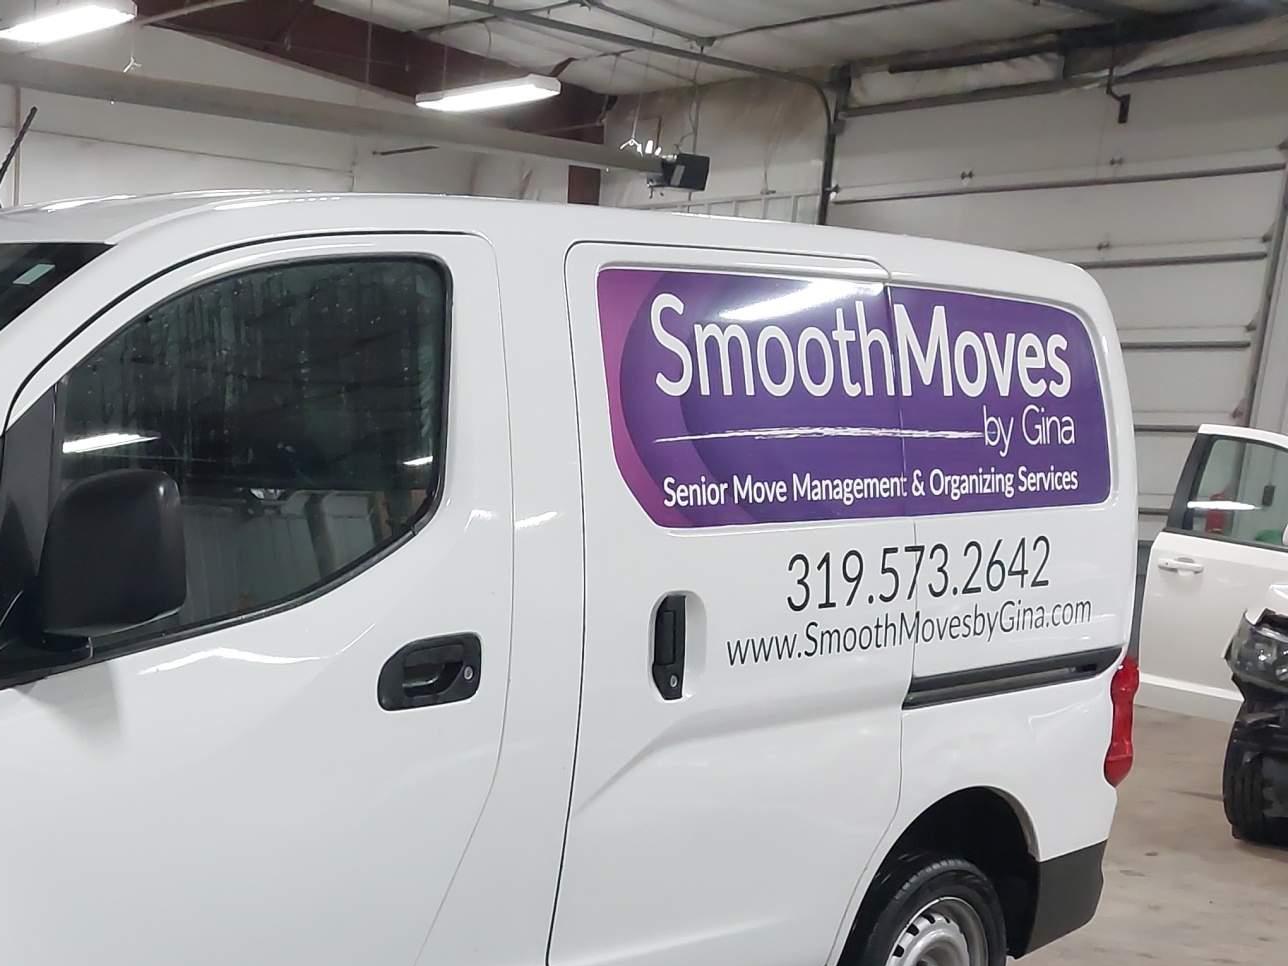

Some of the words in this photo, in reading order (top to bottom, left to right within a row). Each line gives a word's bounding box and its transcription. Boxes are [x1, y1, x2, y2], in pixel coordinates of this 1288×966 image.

[650, 293, 1072, 398] SmoothMoves
[982, 404, 1014, 457] by
[1021, 404, 1075, 446] Gina
[663, 475, 728, 508] Senior
[732, 473, 788, 505] Move
[792, 471, 908, 506] Management
[911, 468, 926, 497] &
[929, 466, 1015, 501] Organizing
[1017, 464, 1079, 492] Services
[786, 535, 1050, 613] 319.573.2642
[726, 599, 1092, 667] www.SmoothMovesbyGina.com
